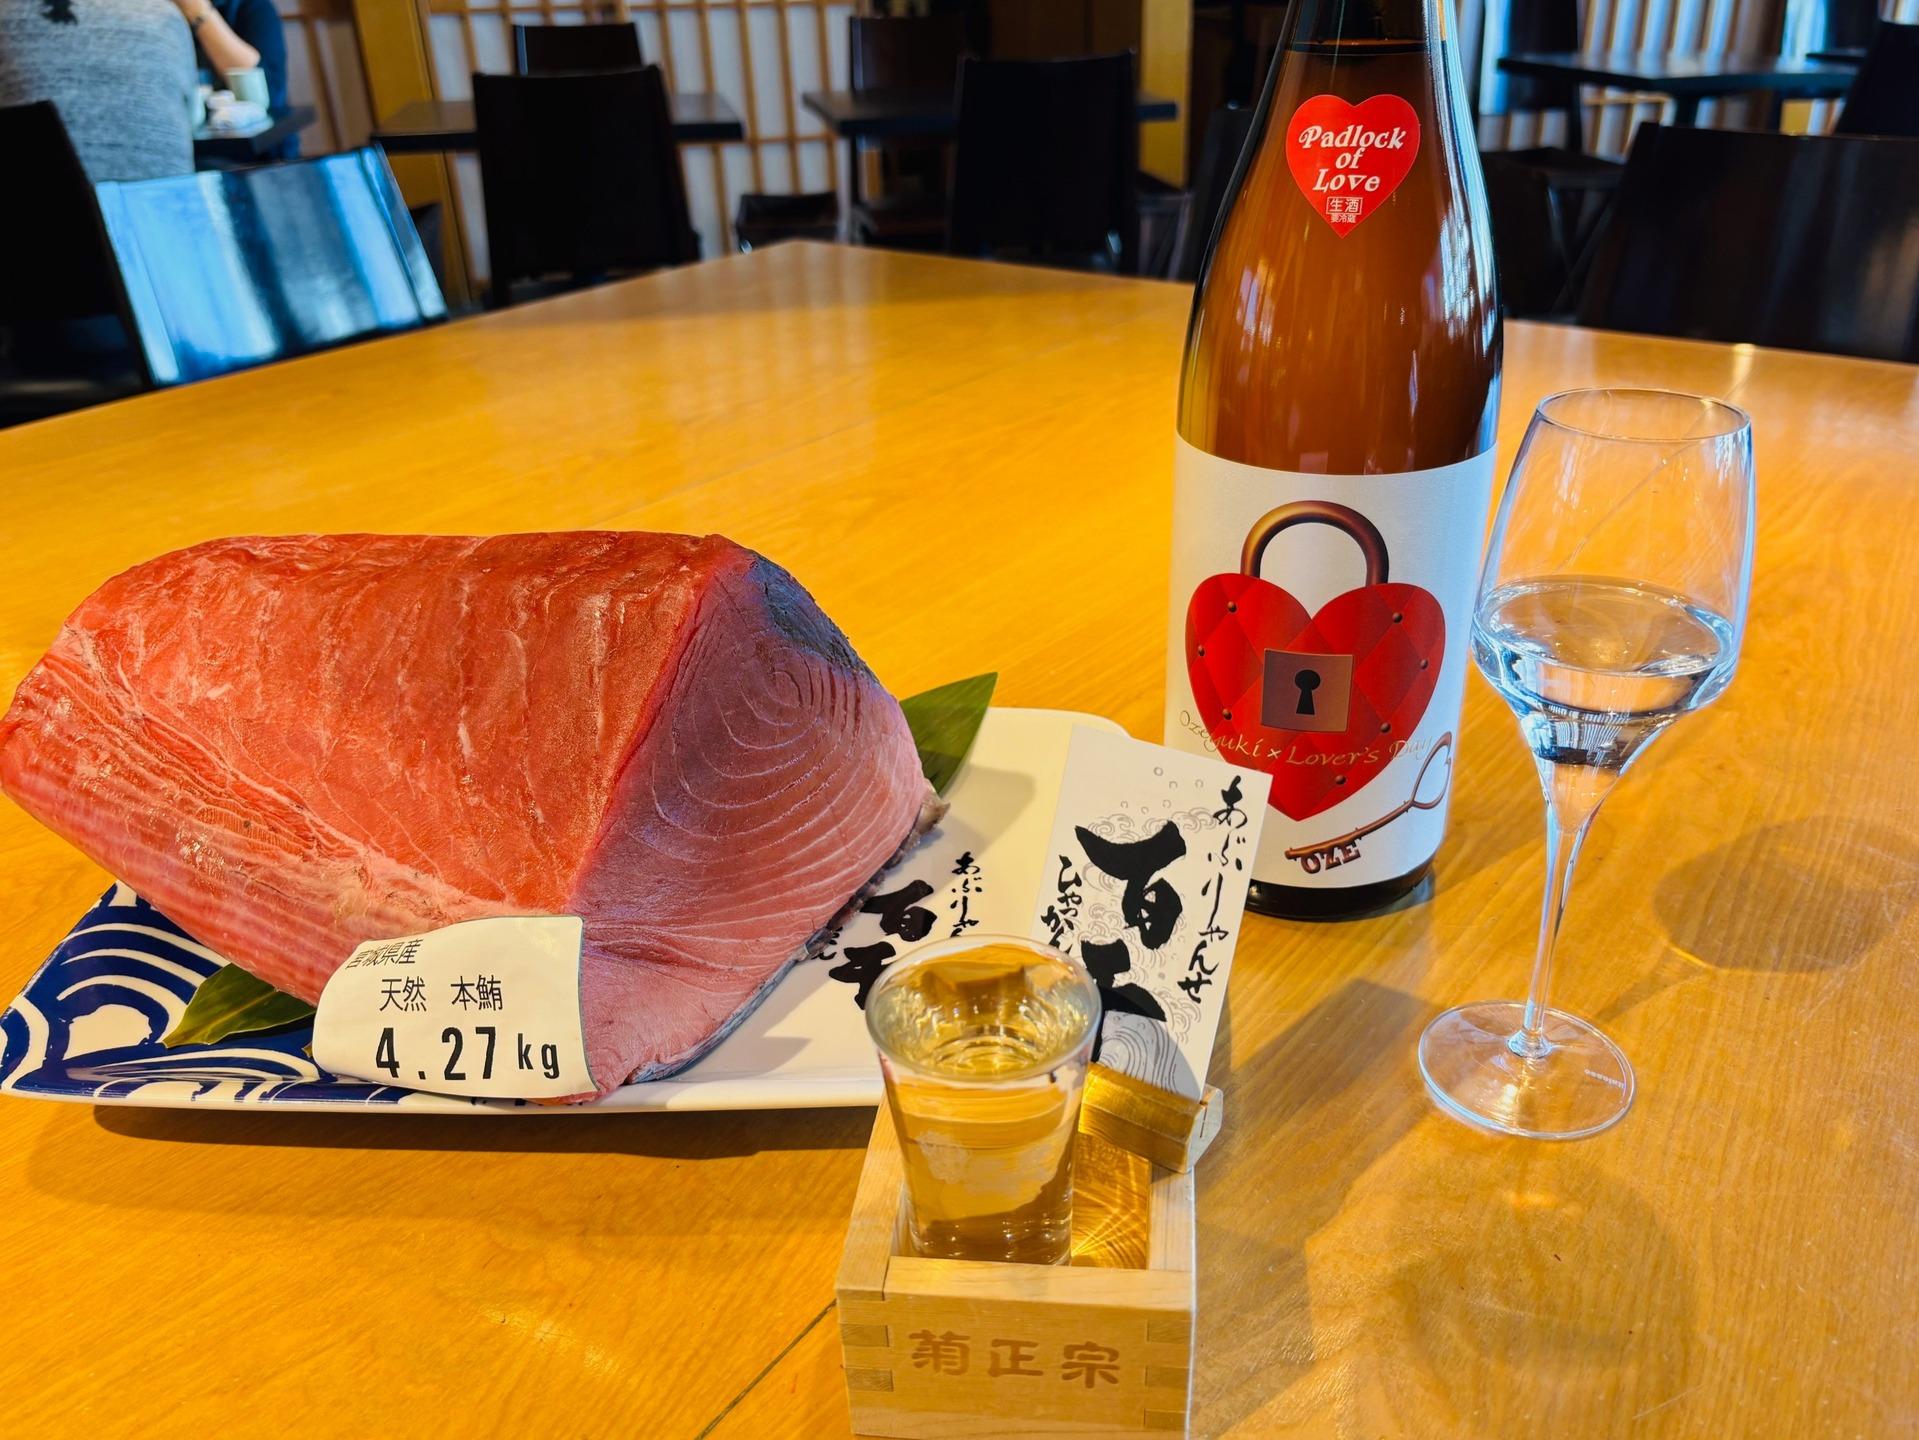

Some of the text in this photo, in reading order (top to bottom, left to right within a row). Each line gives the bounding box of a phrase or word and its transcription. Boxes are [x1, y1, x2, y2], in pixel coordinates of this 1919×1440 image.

[1298, 124, 1407, 150] Padlock
[1335, 147, 1366, 169] of
[1312, 168, 1381, 193] Love
[1329, 198, 1360, 213] 生酒
[1286, 746, 1380, 767] Lover's
[1300, 841, 1362, 874] OZE
[345, 938, 424, 970] 宮城県産
[379, 974, 503, 1012] 天然 本鮪
[375, 1026, 560, 1081] 4.27 kg
[908, 1329, 1121, 1389] 菊正宗
